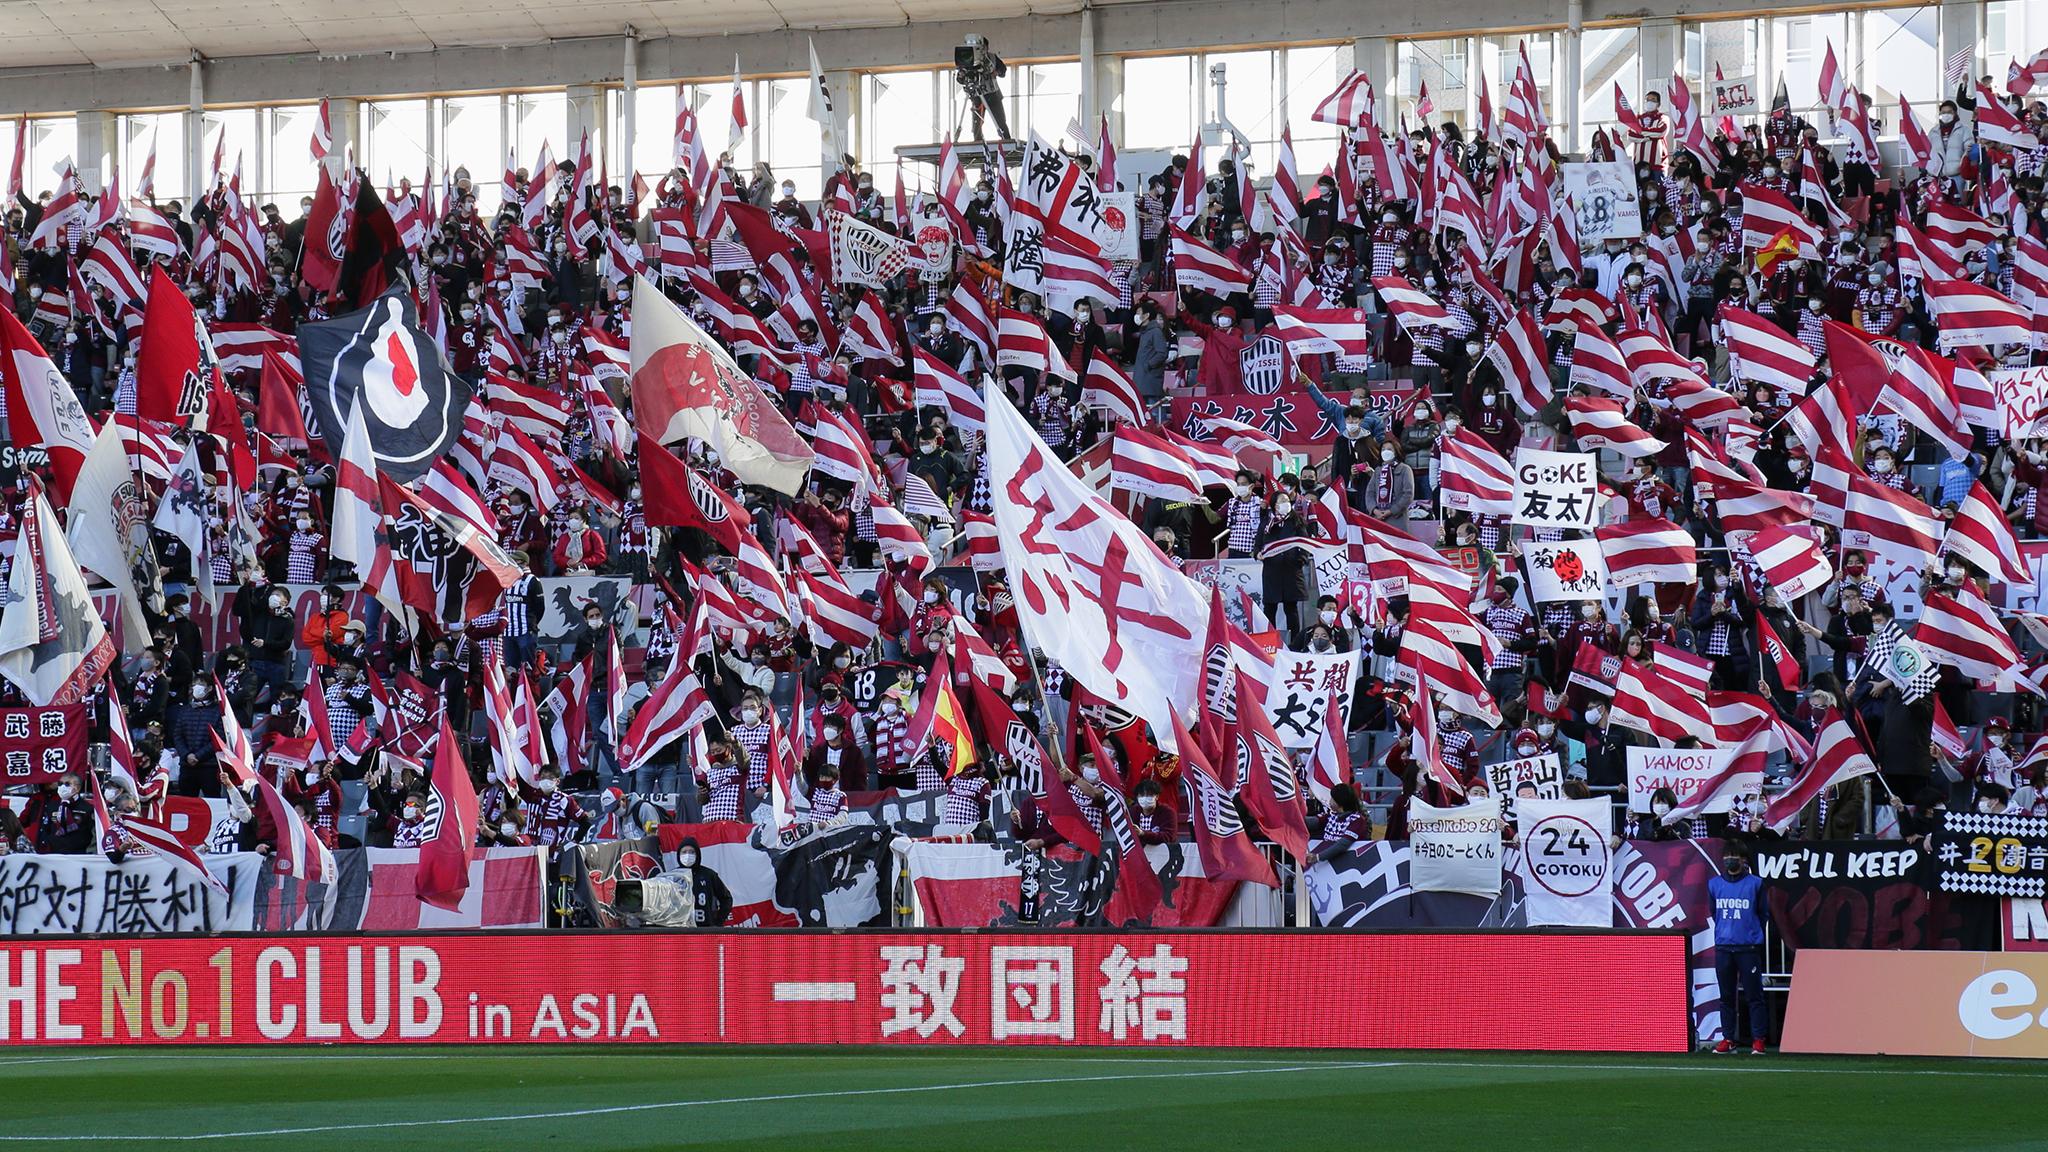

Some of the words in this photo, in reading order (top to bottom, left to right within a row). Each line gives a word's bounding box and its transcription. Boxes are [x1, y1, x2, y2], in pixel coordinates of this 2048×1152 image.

[1595, 196, 1607, 221] 8
[1246, 358, 1281, 371] VISSEL
[50, 377, 70, 433] KOBE
[1521, 489, 1583, 523] 友太
[854, 671, 876, 700] 18
[5, 711, 65, 738] 武藤
[6, 748, 67, 777] 嘉紀
[1514, 761, 1534, 782] 23
[1644, 754, 1711, 771] VAMOS!
[1410, 819, 1443, 832] Vissel
[1445, 819, 1477, 832] Kobe
[1480, 819, 1497, 832] 24
[1415, 842, 1495, 859] #今日のごーとくん
[1540, 828, 1590, 856] 24
[1536, 863, 1601, 877] GOTOKU
[1758, 849, 1838, 879] WE'LL
[1847, 849, 1918, 879] KEEP
[1716, 898, 1750, 909] HYOGO
[0, 949, 83, 1040] HE
[101, 948, 234, 1039] No.1
[255, 946, 444, 1040] CLUB
[468, 994, 512, 1039] in
[530, 993, 660, 1039] ASIA
[772, 943, 1189, 1042] 一致団結
